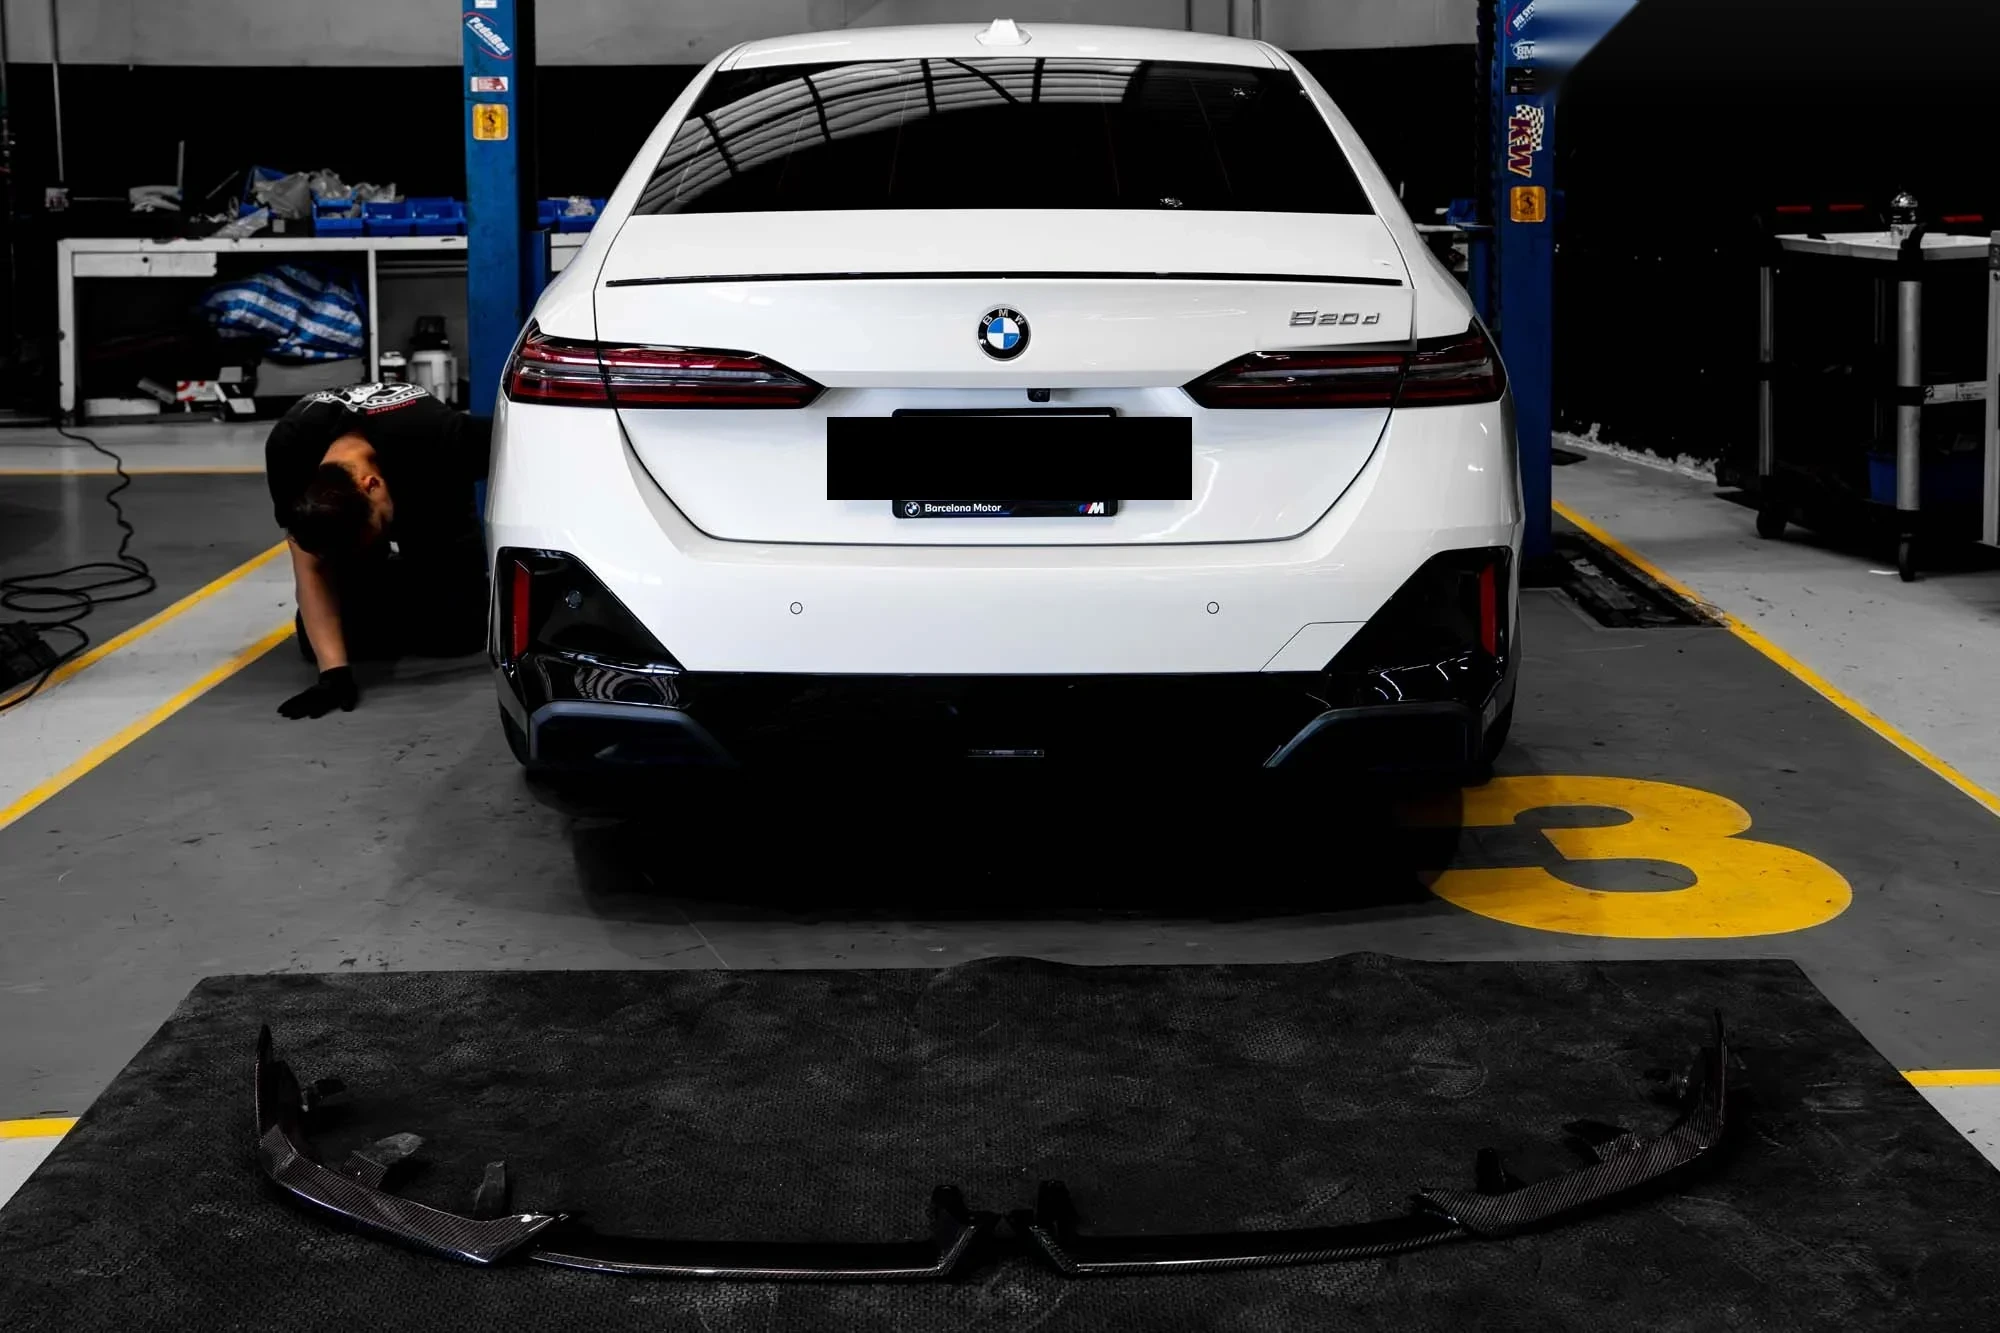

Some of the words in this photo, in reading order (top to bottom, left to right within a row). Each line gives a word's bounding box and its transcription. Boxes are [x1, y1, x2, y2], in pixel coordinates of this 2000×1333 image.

[468, 16, 510, 53] PedalBox
[1517, 46, 1535, 57] BM
[1508, 115, 1532, 178] KW
[983, 309, 1025, 326] BMW
[1290, 310, 1380, 326] 520d
[924, 503, 972, 513] Barcelona
[973, 503, 1002, 513] Motor
[1430, 775, 1853, 939] 3
